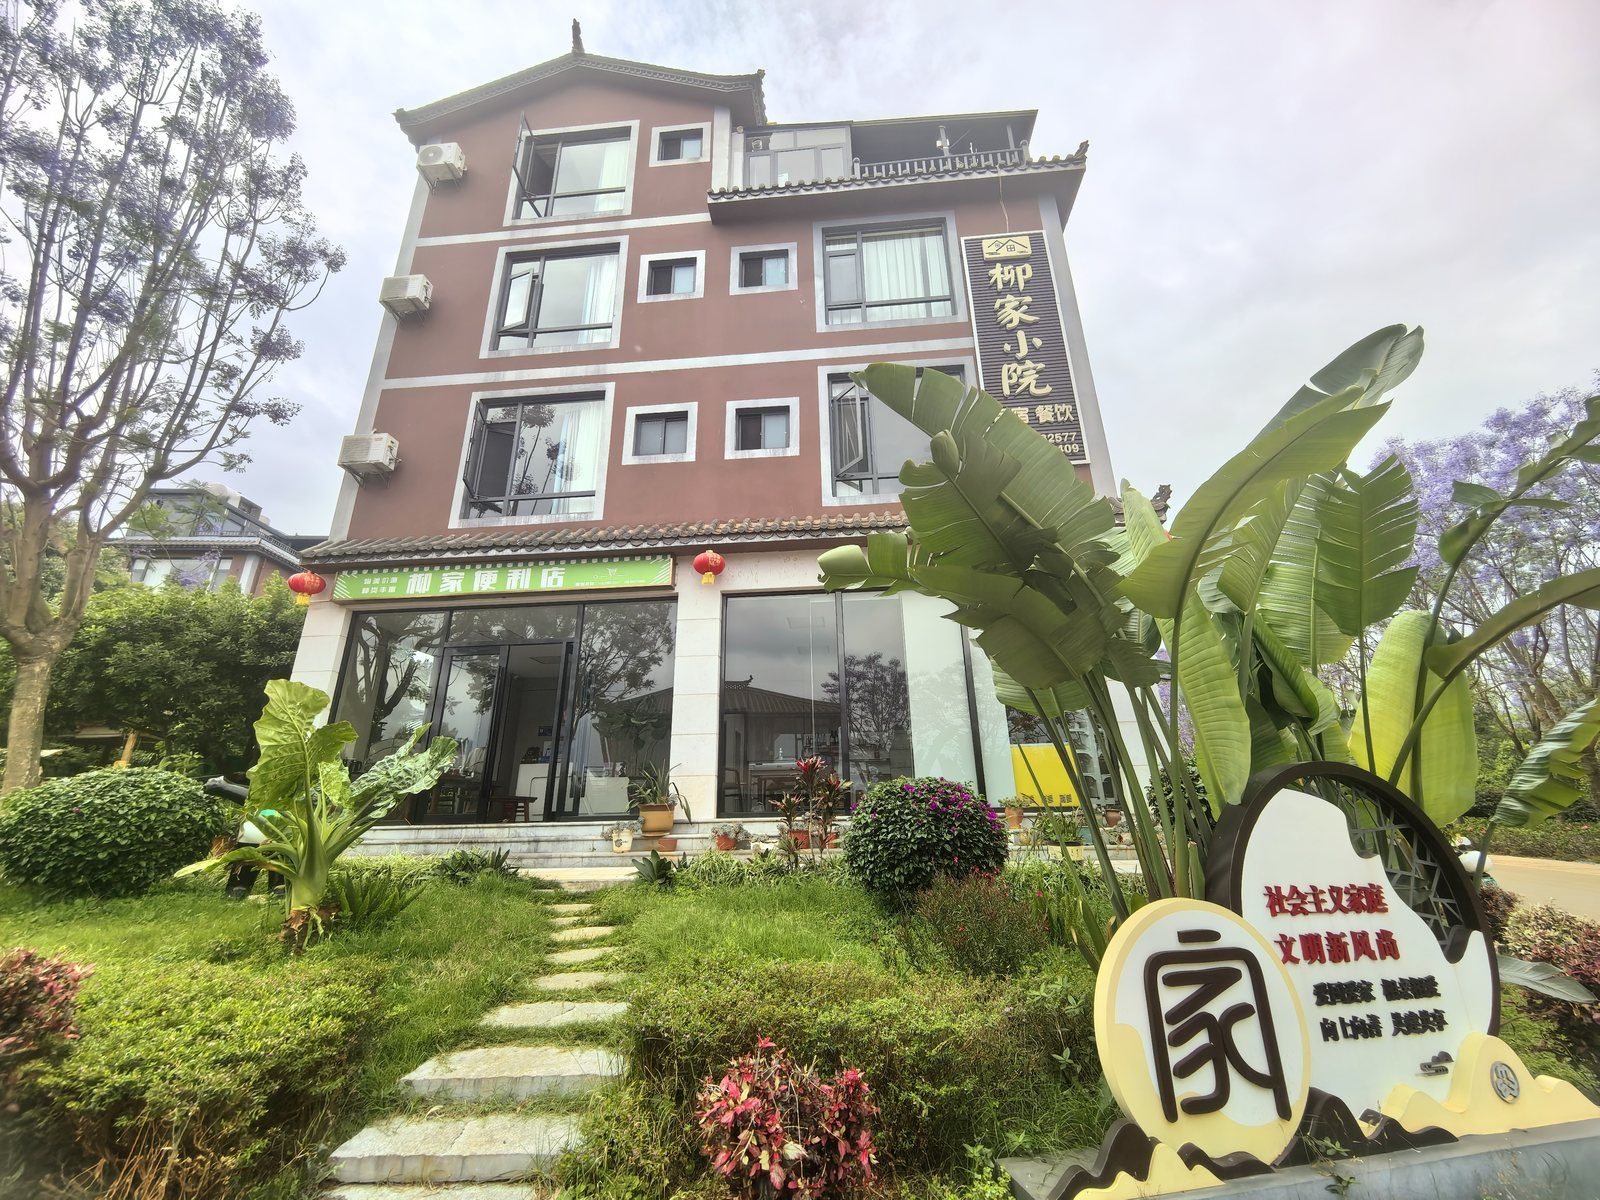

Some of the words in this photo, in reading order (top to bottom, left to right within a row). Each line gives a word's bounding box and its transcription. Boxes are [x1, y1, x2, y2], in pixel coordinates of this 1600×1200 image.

[988, 262, 1053, 398] 柳家小院
[1035, 403, 1075, 424] 餐饮
[406, 567, 566, 594] 柳家便利店
[1263, 883, 1389, 917] 社会主义家庭
[1274, 929, 1400, 964] 文明新风尚
[1320, 1014, 1383, 1042] 向上向善
